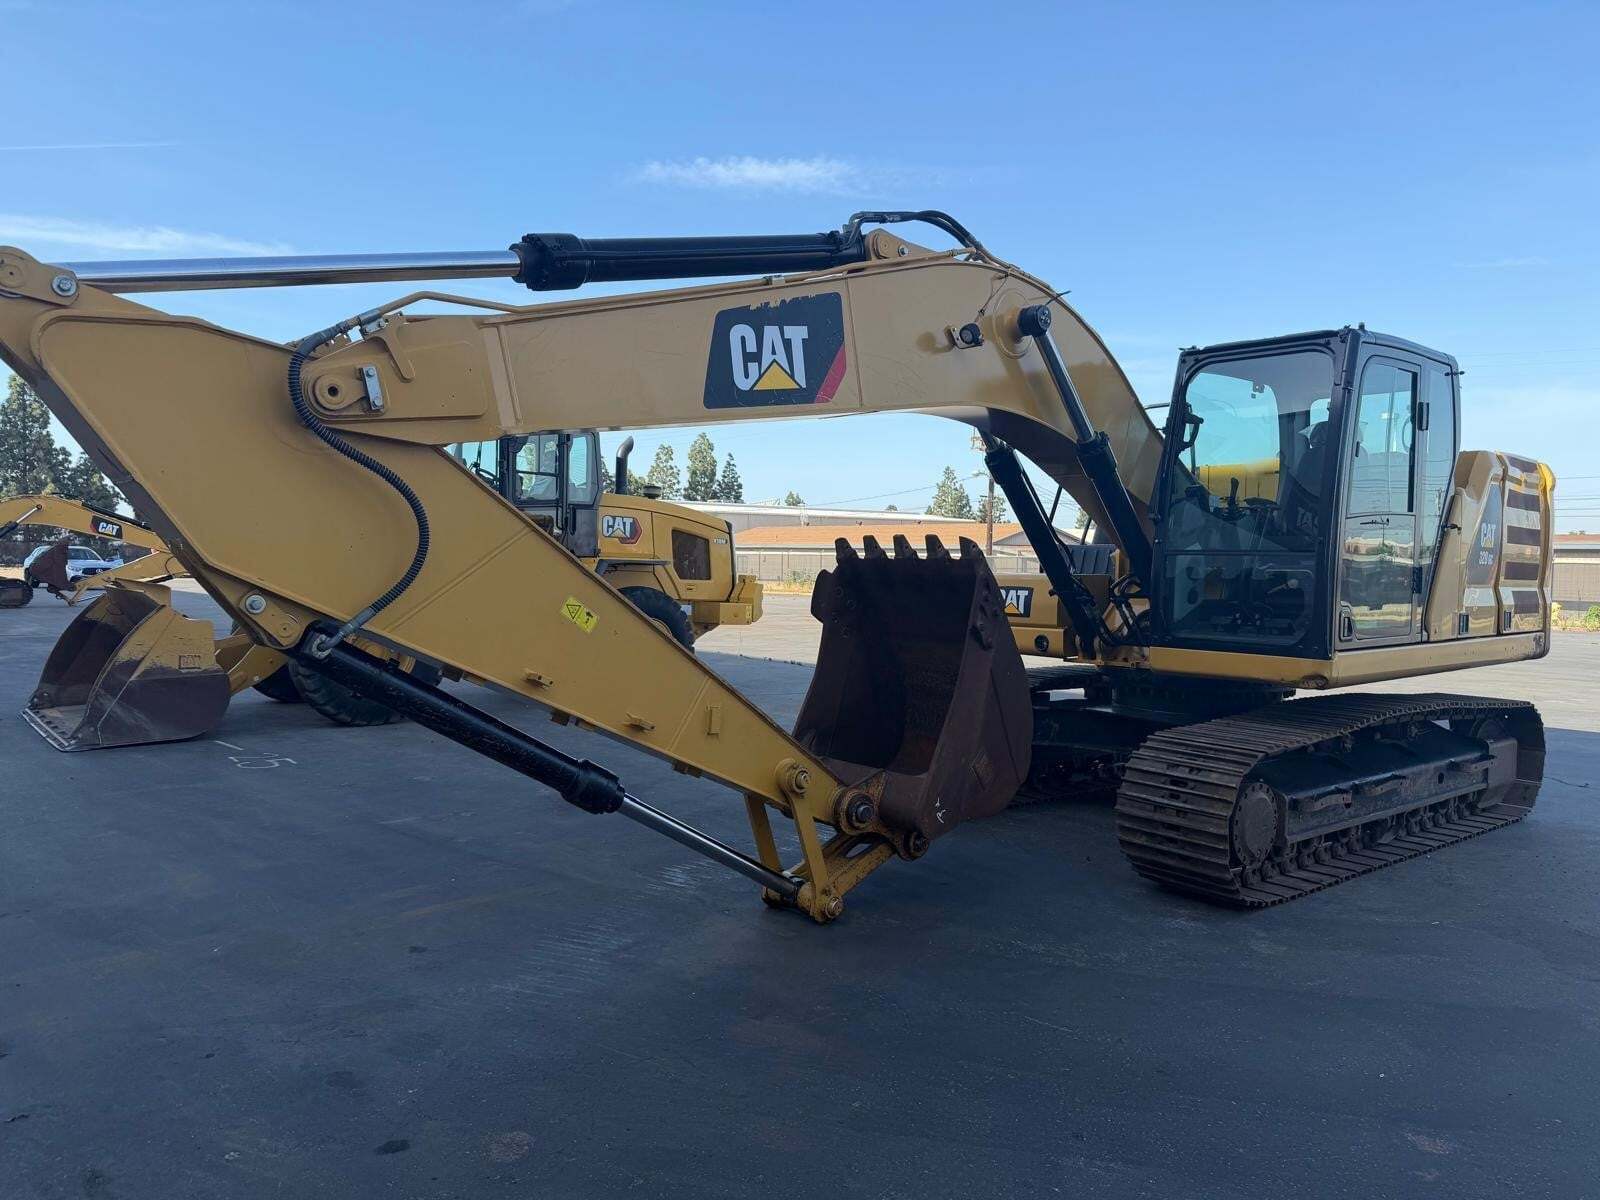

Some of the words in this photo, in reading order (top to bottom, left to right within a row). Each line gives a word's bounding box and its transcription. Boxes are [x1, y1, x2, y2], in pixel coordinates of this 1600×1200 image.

[729, 324, 809, 391] CAT
[98, 522, 120, 536] CAT
[602, 515, 634, 538] CAT
[1480, 522, 1497, 548] CAT
